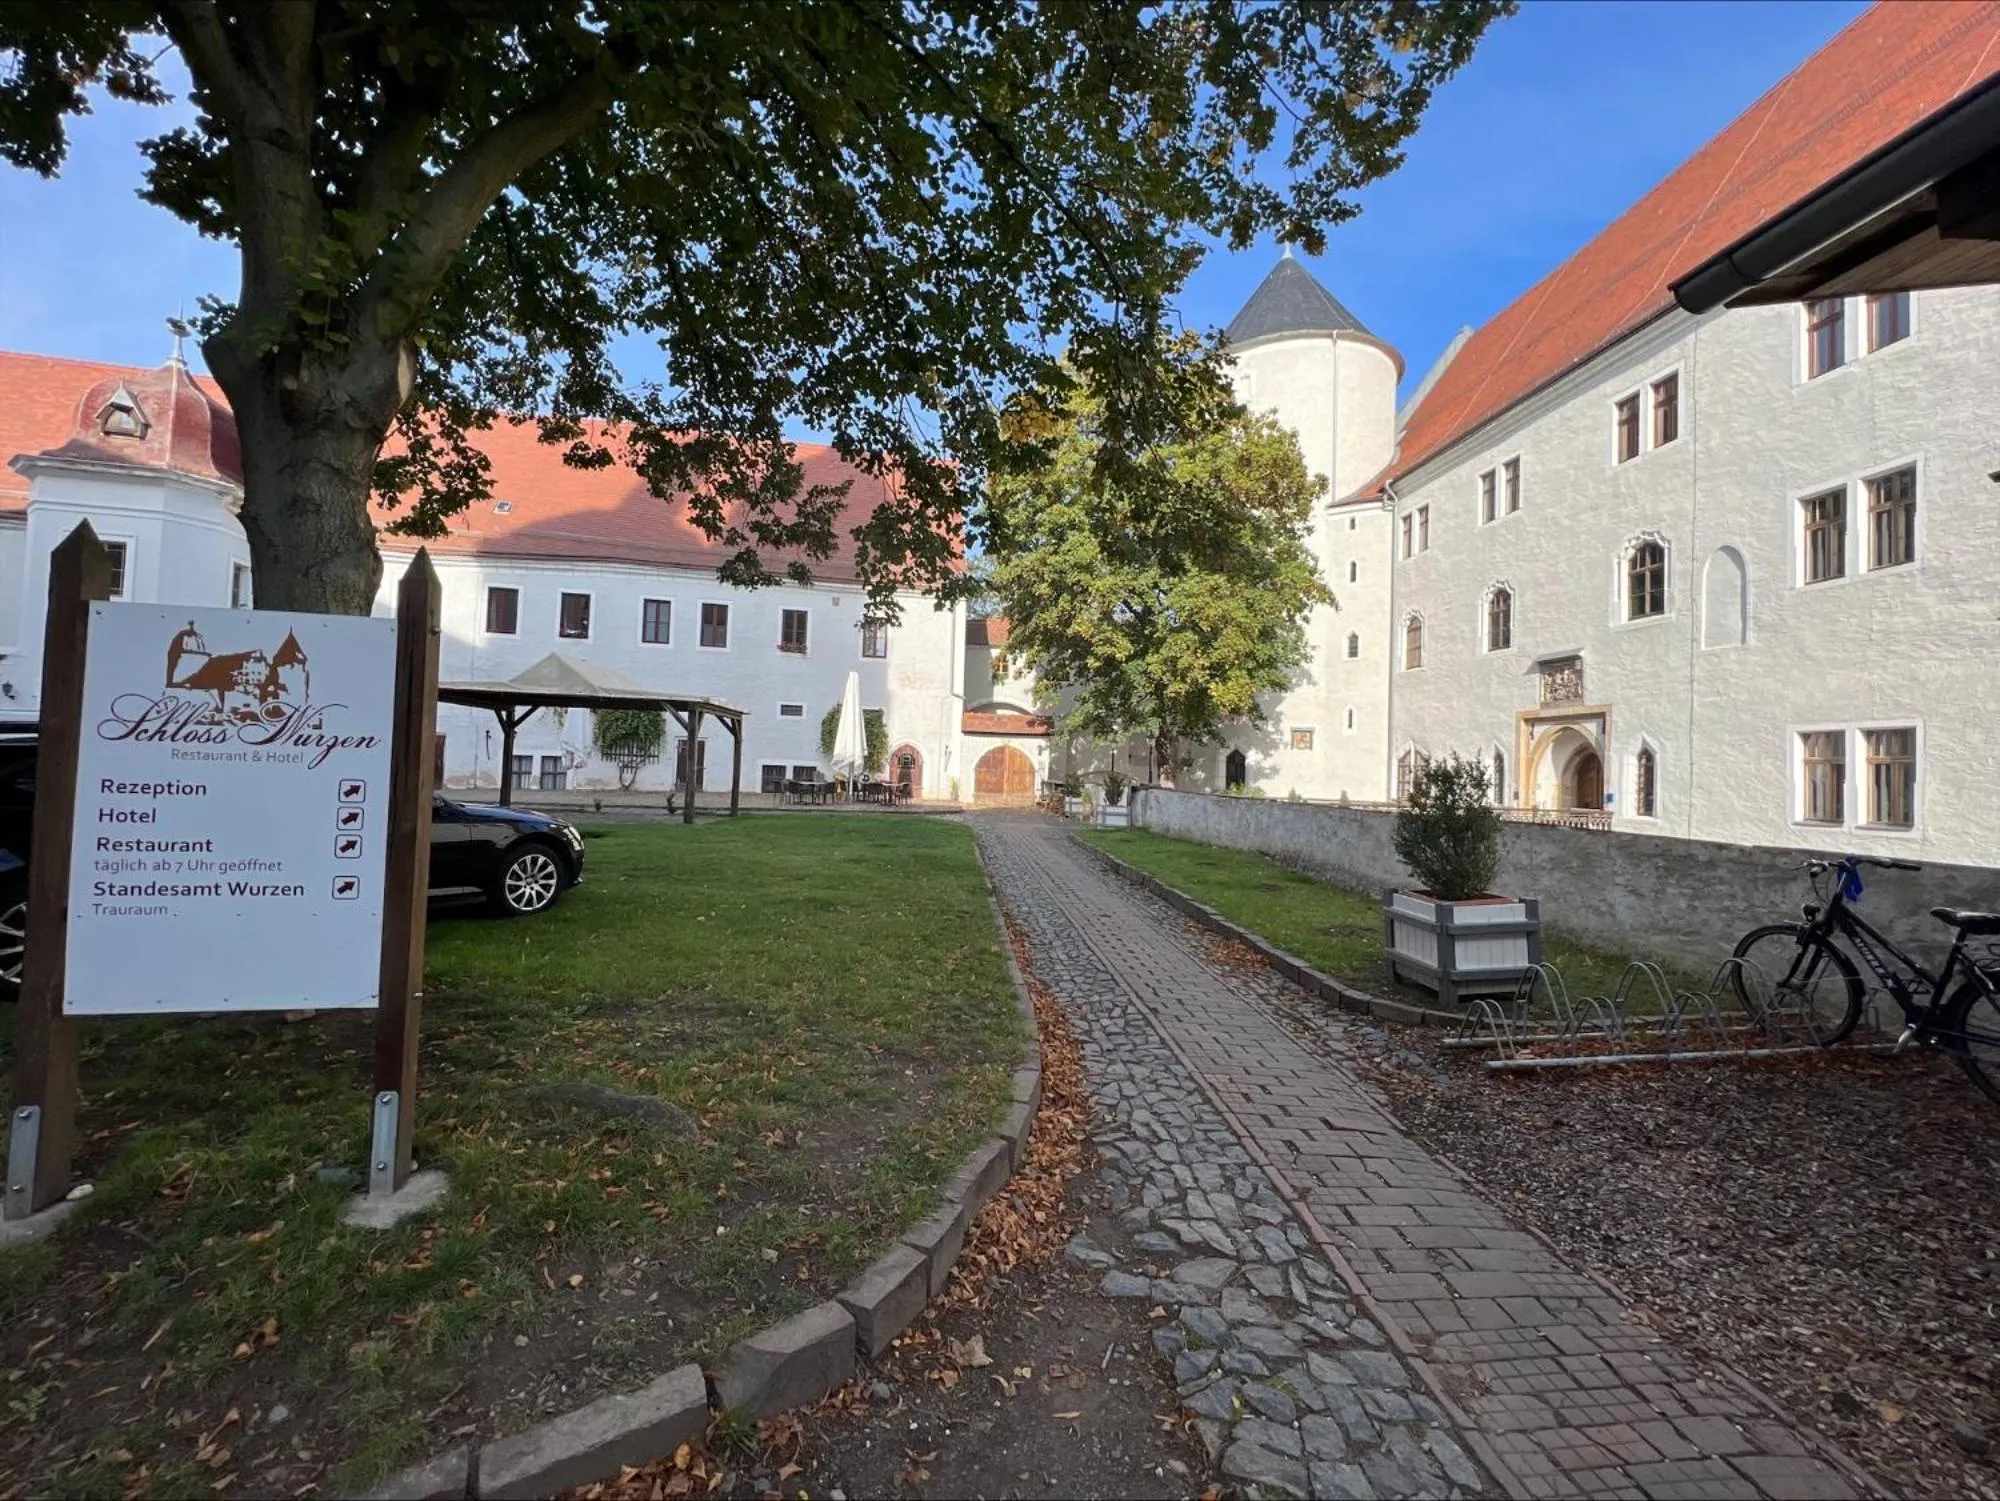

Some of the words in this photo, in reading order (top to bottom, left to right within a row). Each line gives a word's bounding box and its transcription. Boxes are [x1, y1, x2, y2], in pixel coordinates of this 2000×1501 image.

[97, 693, 232, 742] Schloss
[237, 701, 381, 770] Wurzen
[171, 749, 248, 763] Restaurant
[252, 750, 262, 762] &
[266, 751, 304, 763] Hotel
[100, 778, 207, 799] Rezeption
[98, 807, 157, 823] Hotel
[96, 836, 213, 852] Restaurant
[94, 858, 147, 875] täglich
[152, 859, 172, 871] ab
[175, 863, 184, 873] 7
[187, 860, 215, 871] Uhr
[218, 858, 283, 875] geöffnet
[93, 881, 222, 897] Standesamt
[227, 881, 305, 896] Wurzen
[92, 903, 168, 916] Trauraum
